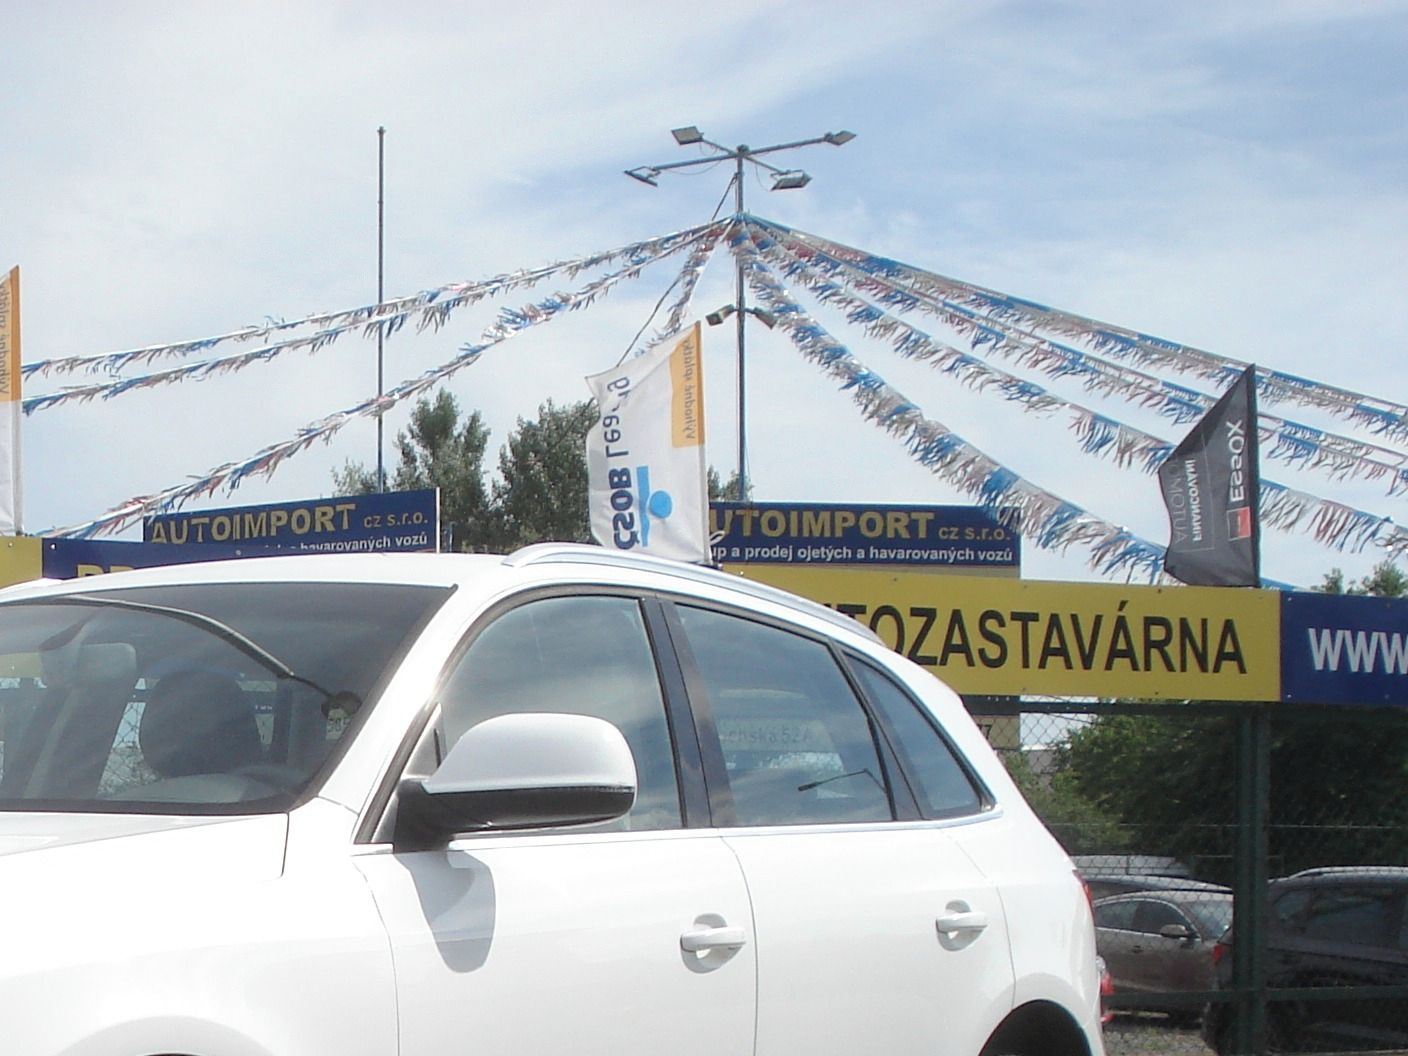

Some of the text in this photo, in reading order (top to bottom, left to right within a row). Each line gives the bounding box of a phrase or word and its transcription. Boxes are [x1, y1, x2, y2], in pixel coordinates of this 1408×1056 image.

[151, 503, 429, 544] AUTOIMPORT cz s.r.o.
[395, 531, 428, 546] vozů
[710, 509, 1011, 541] UTOIMPORT cz s.r.o.
[731, 546, 740, 557] a
[745, 545, 793, 561] prodej
[798, 543, 851, 562] ojetých
[856, 548, 865, 559] a
[869, 546, 975, 564] havarovaných
[978, 546, 1012, 561] vozů
[835, 600, 1248, 675] OZASTAVÁRNA
